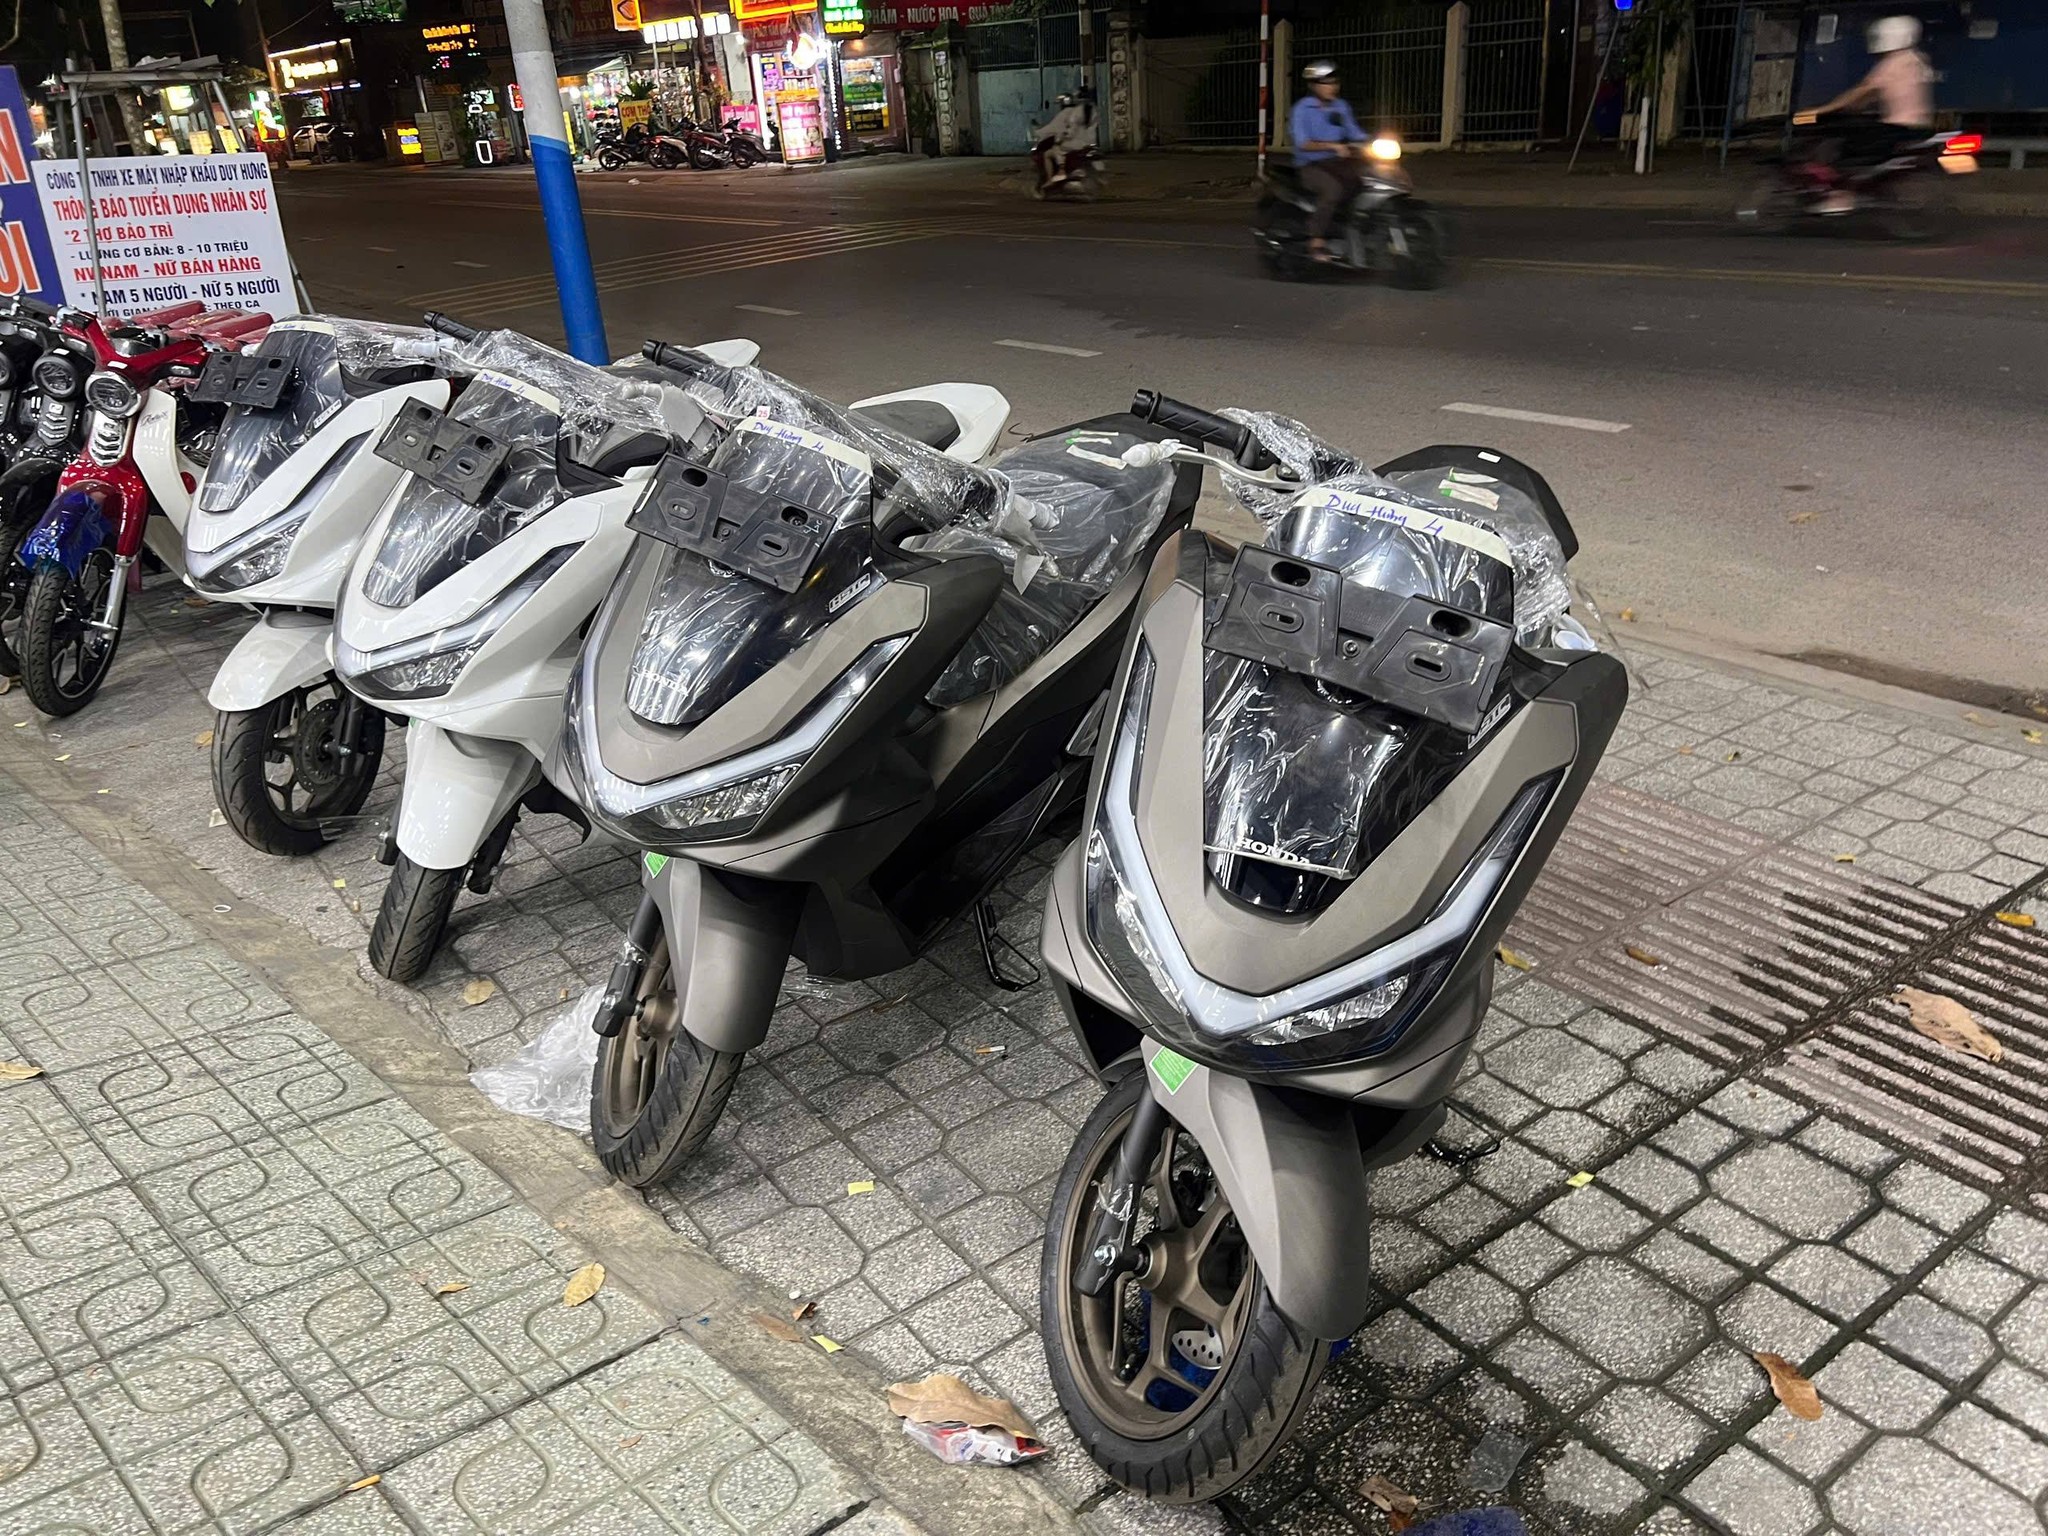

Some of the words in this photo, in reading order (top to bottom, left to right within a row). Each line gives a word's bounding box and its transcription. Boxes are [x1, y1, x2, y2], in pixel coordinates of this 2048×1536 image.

[907, 3, 936, 23] NƯỚC
[938, 6, 959, 21] HOA
[46, 168, 76, 190] CÔNG
[90, 168, 120, 188] TNHH
[120, 168, 135, 186] XE
[135, 164, 159, 185] MÁY
[160, 162, 187, 187] NHẬP
[189, 158, 217, 182] KHẨU
[219, 163, 239, 181] DUY
[240, 161, 268, 180] HƯNG
[100, 193, 127, 218] BÁO
[128, 187, 172, 216] TUYỂN
[172, 193, 210, 218] DỤNG
[210, 187, 248, 213] NHÂN
[249, 187, 267, 214] SỰ
[116, 222, 146, 240] BẢO
[149, 221, 174, 238] TRÌ
[123, 246, 141, 258] CƠ
[144, 243, 174, 256] BẢN:
[177, 245, 185, 254] 8
[197, 243, 211, 254] 10
[214, 239, 249, 253] TRIỆU
[153, 259, 177, 276] NỮ
[181, 258, 214, 275] BÁN
[218, 255, 261, 272] HÀNG
[129, 288, 140, 303] 5
[142, 282, 188, 302] NGƯỜI
[200, 280, 221, 298] NỮ
[224, 282, 234, 296] 5
[237, 276, 280, 295] NGƯỜI
[213, 300, 242, 311] THEO
[245, 300, 261, 308] CA
[1423, 517, 1445, 536] 4
